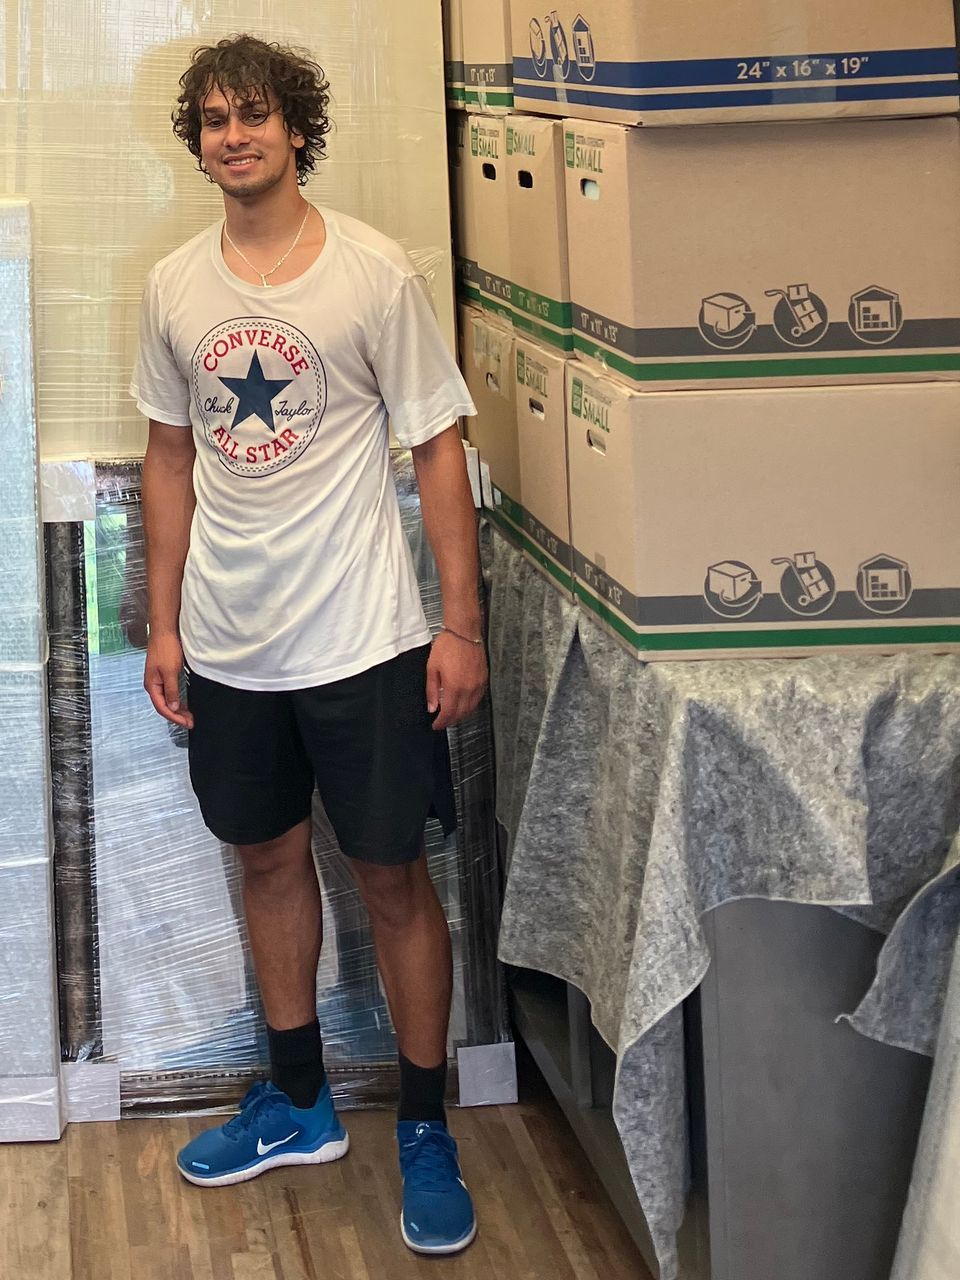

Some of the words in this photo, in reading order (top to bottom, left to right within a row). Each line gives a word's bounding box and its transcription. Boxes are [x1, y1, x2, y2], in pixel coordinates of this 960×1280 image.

[736, 61, 771, 80] 24"
[776, 66, 787, 78] x
[792, 59, 820, 77] 16"
[825, 63, 836, 75] x
[841, 56, 869, 74] 19"
[479, 138, 499, 159] SMALL
[513, 132, 535, 156] SMALL
[576, 146, 603, 173] SMALL
[203, 329, 310, 376] CONVERSE
[525, 366, 548, 398] SMALL
[204, 396, 235, 414] Chuck
[274, 400, 315, 421] Taylor
[583, 397, 610, 433] SMALL
[213, 425, 239, 460] ALL
[246, 427, 300, 463] STAR
